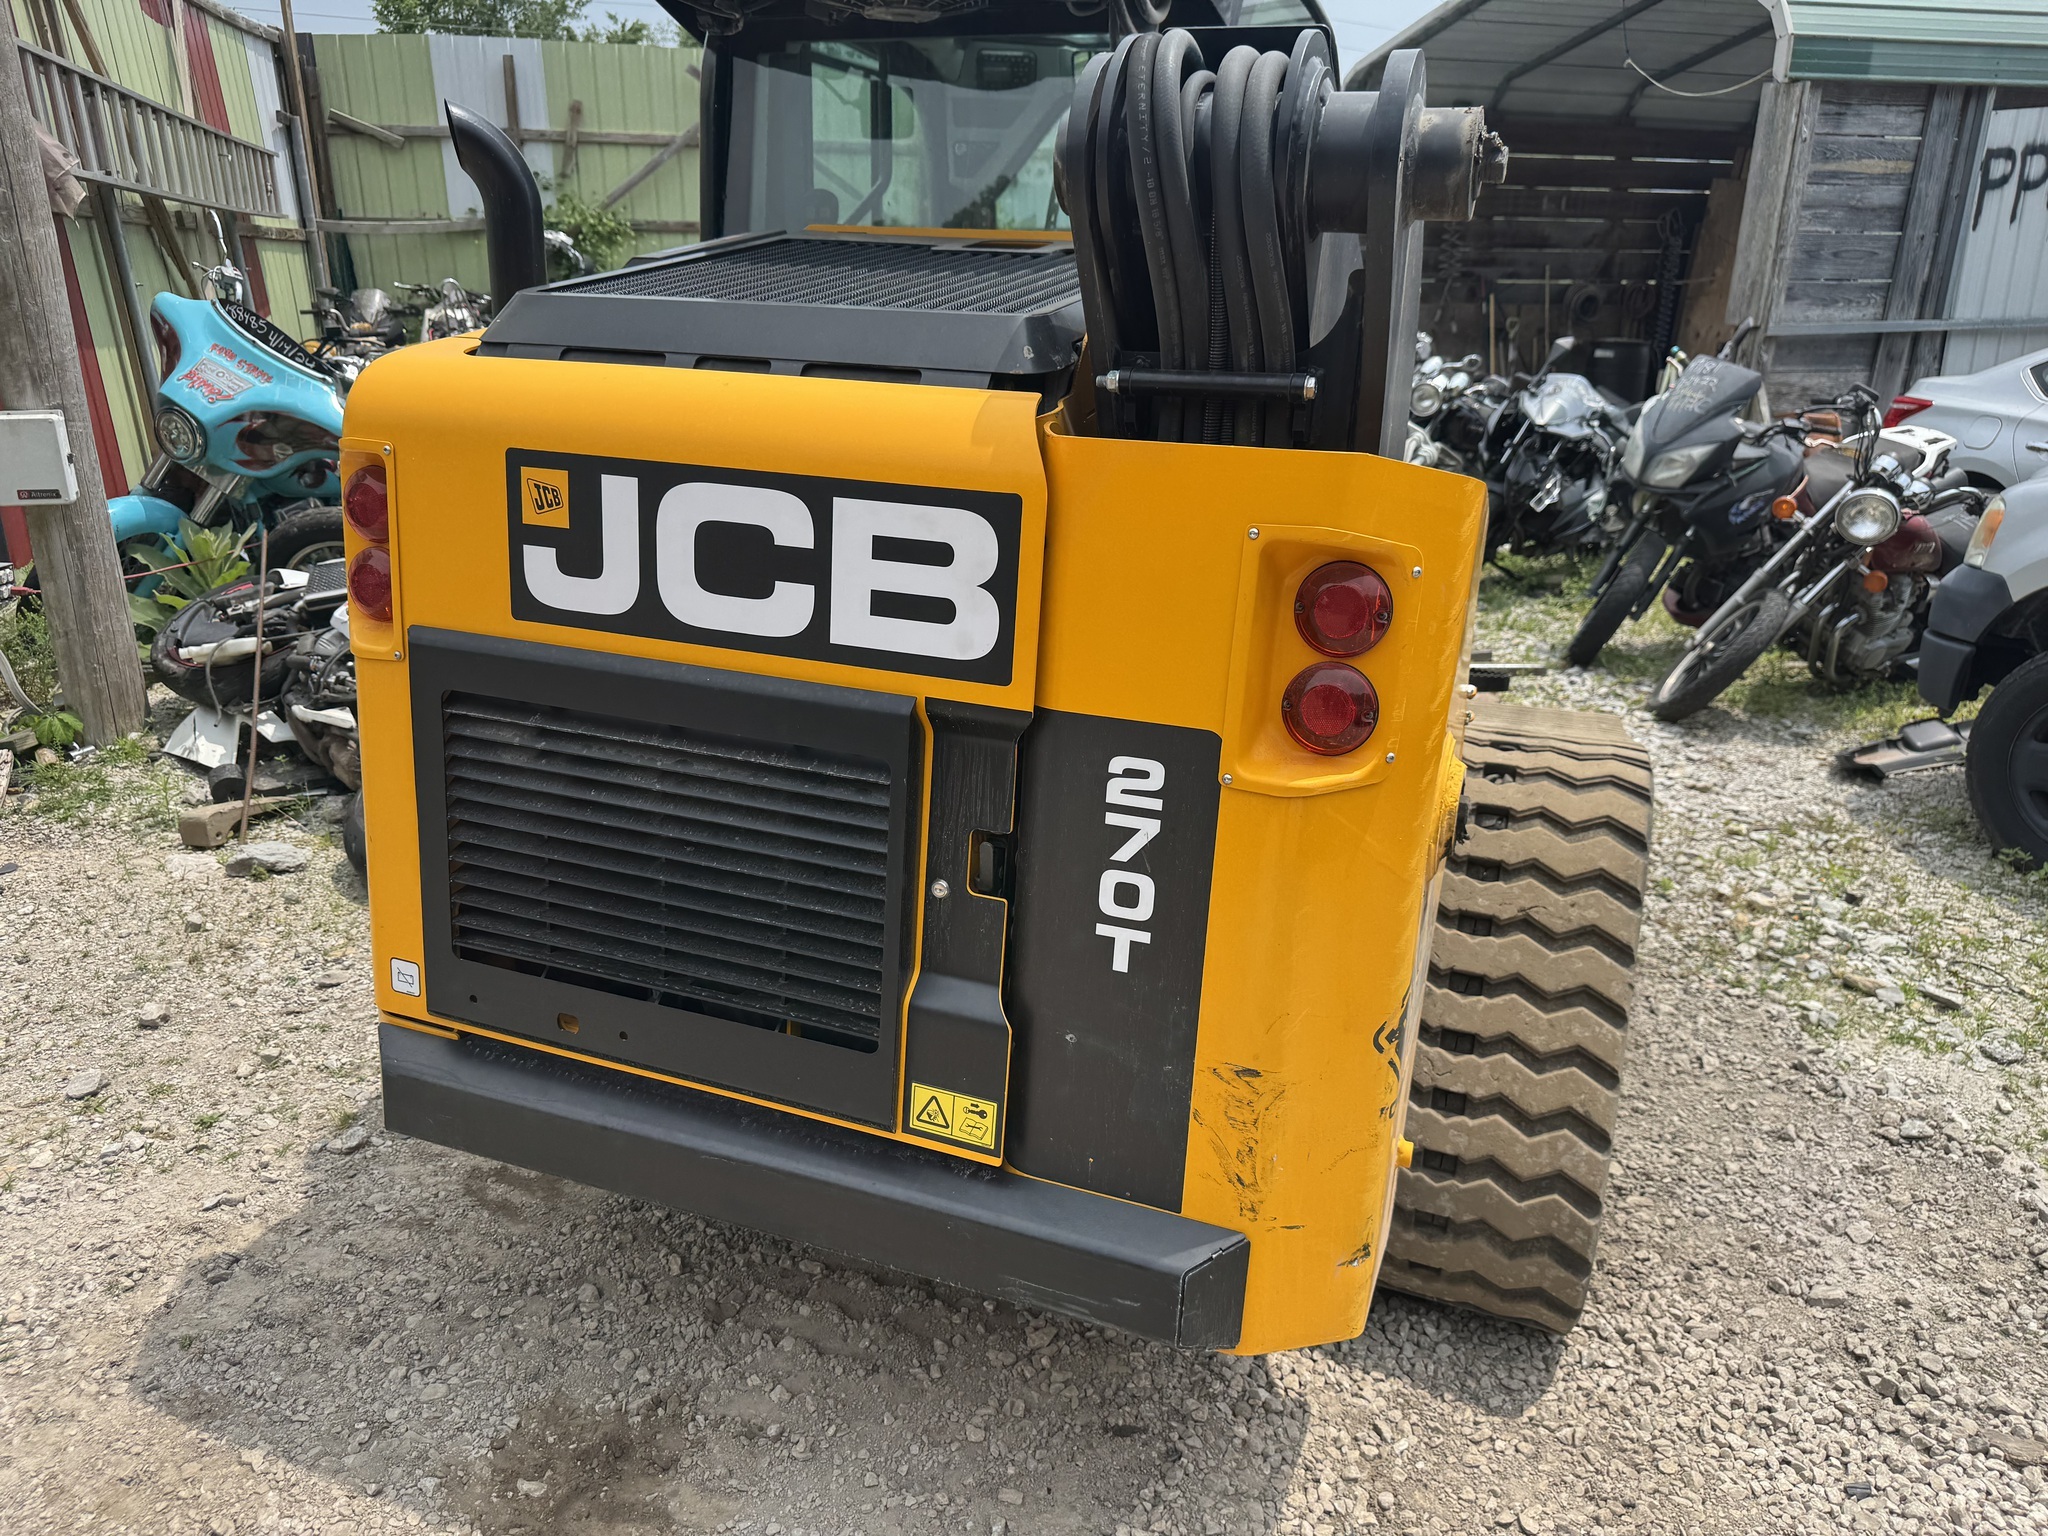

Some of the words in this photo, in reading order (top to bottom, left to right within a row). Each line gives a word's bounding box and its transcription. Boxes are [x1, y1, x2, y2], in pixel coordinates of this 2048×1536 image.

[1972, 145, 2048, 231] PP
[533, 482, 561, 511] JCB
[523, 473, 1000, 661] JCB
[1095, 755, 1166, 974] 270T
